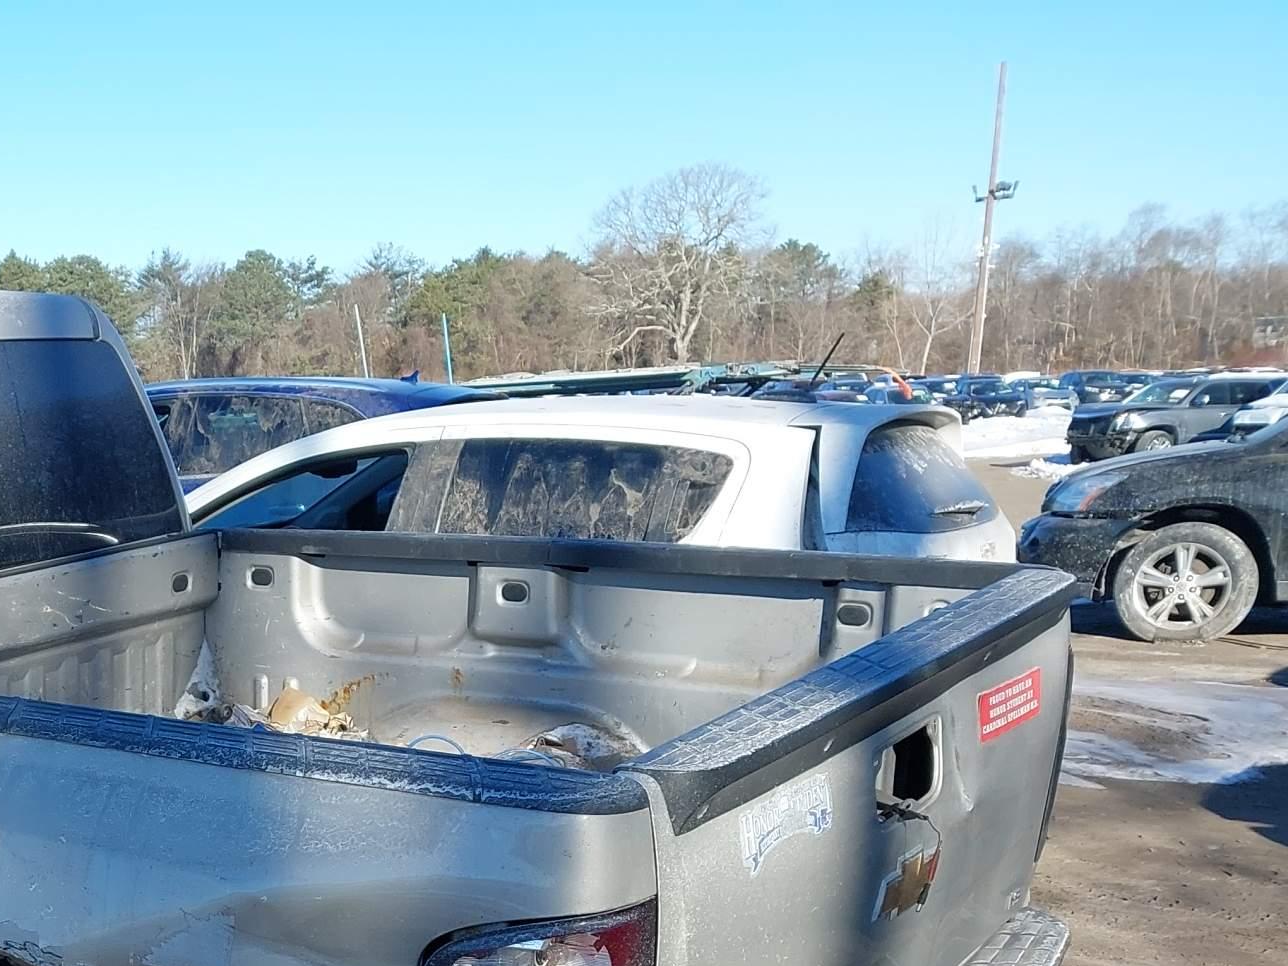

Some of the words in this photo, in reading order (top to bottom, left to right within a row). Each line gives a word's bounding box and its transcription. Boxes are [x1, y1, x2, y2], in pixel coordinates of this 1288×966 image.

[989, 691, 1006, 706] PROUD
[1005, 687, 1012, 698] TO
[1012, 681, 1025, 695] HAVE
[989, 703, 1007, 719] HONOR
[1006, 692, 1027, 711] STUDENT
[1027, 688, 1034, 700] AT
[982, 715, 1008, 735] CARDINAL
[1007, 702, 1031, 723] SPELLMAN
